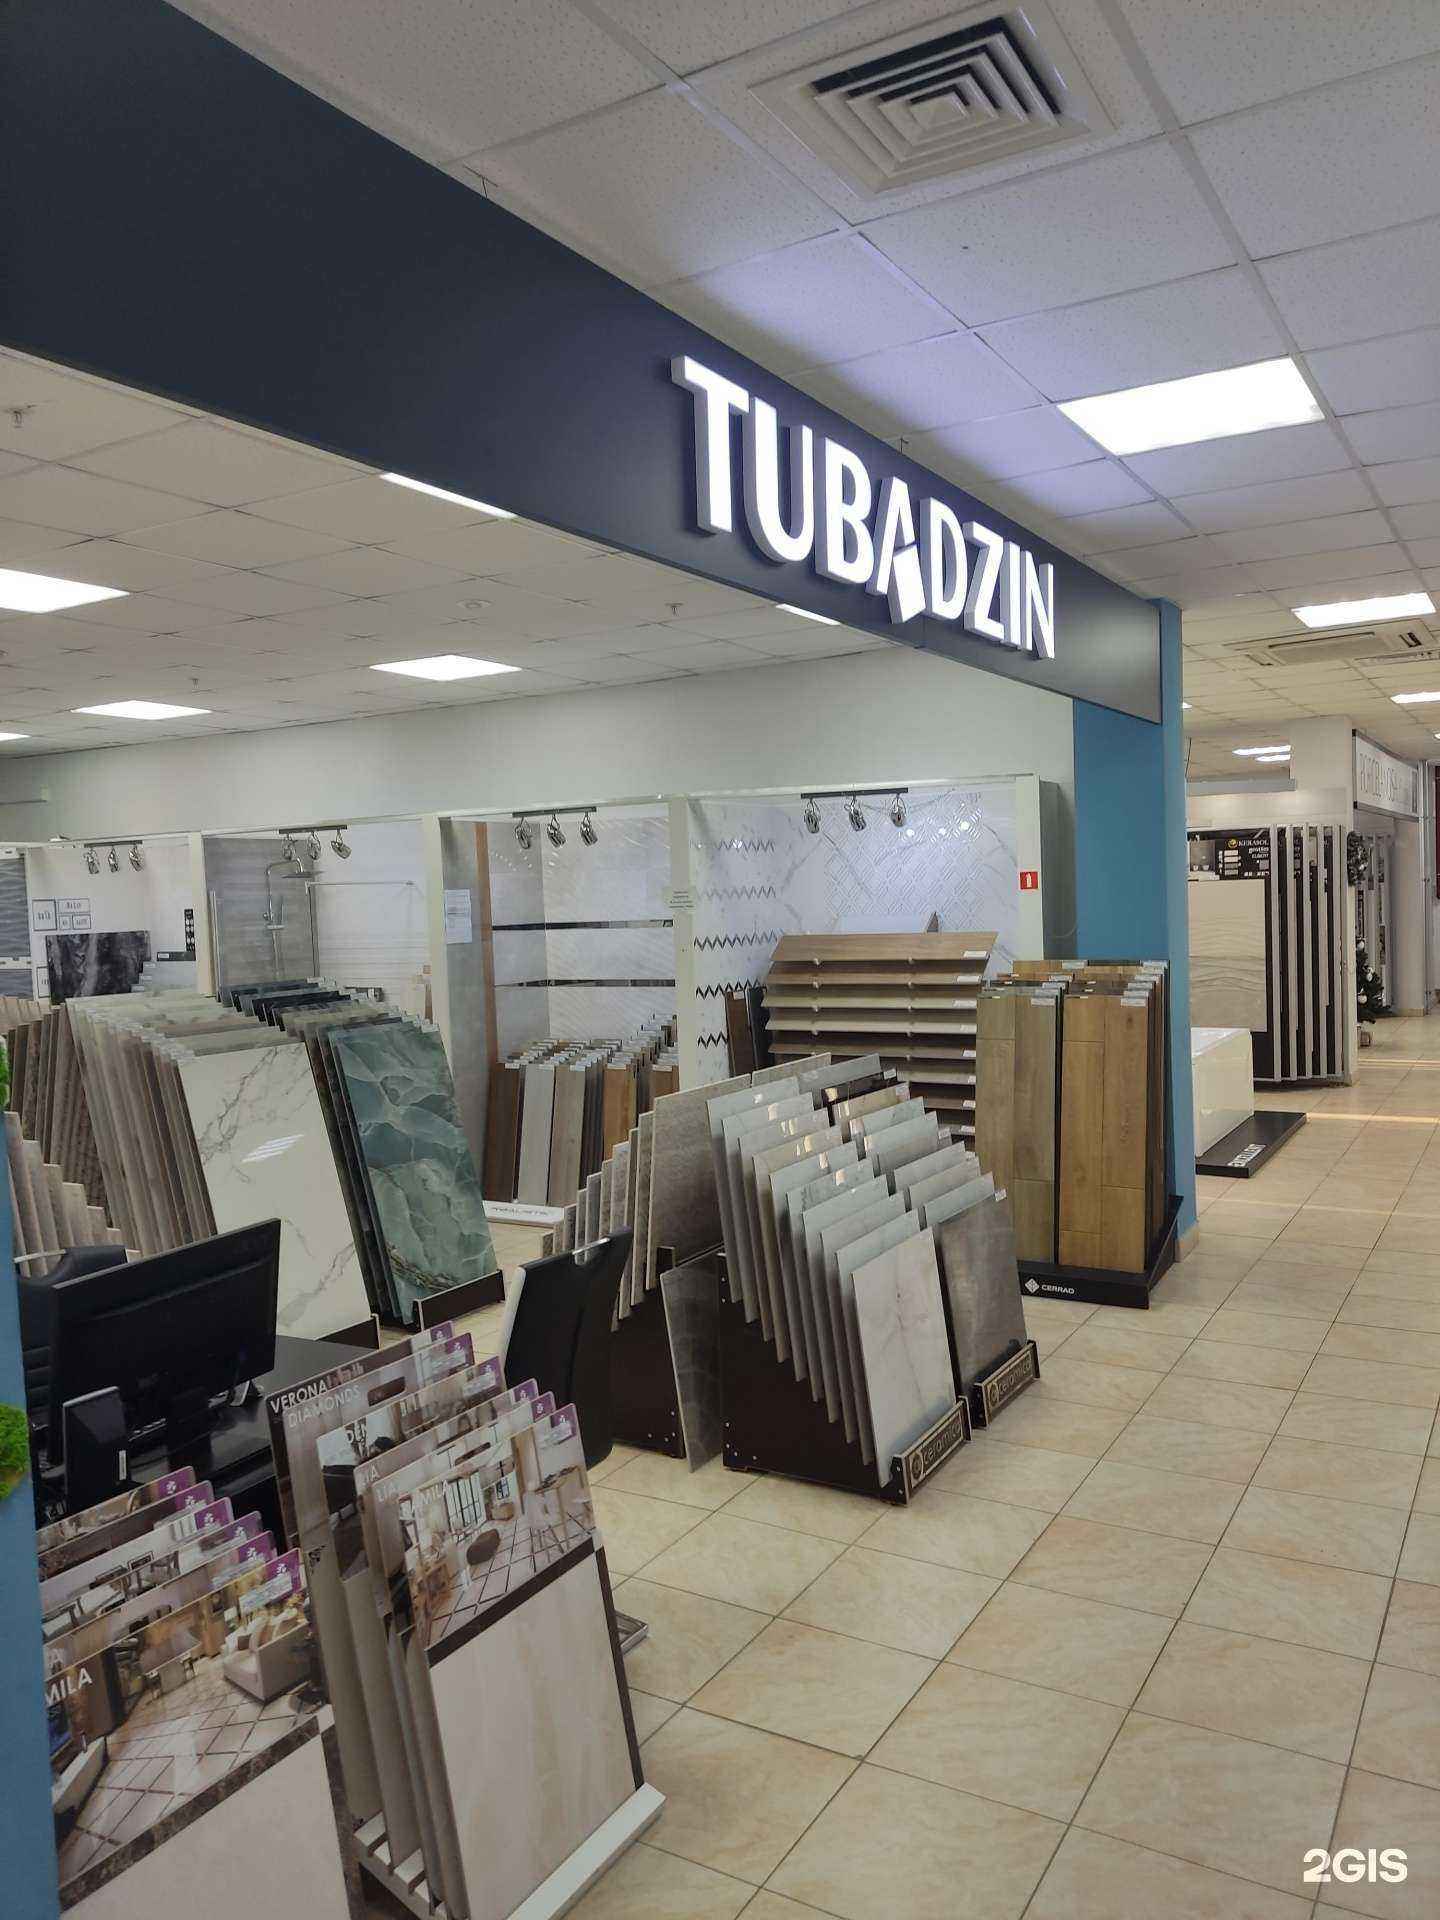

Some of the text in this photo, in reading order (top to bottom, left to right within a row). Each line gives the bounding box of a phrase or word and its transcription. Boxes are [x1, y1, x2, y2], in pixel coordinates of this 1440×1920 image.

[672, 355, 1055, 659] TUBADZIN
[1041, 1284, 1075, 1294] CERRAD
[270, 1380, 328, 1413] VERONA
[287, 1384, 361, 1428] DIAMONDS
